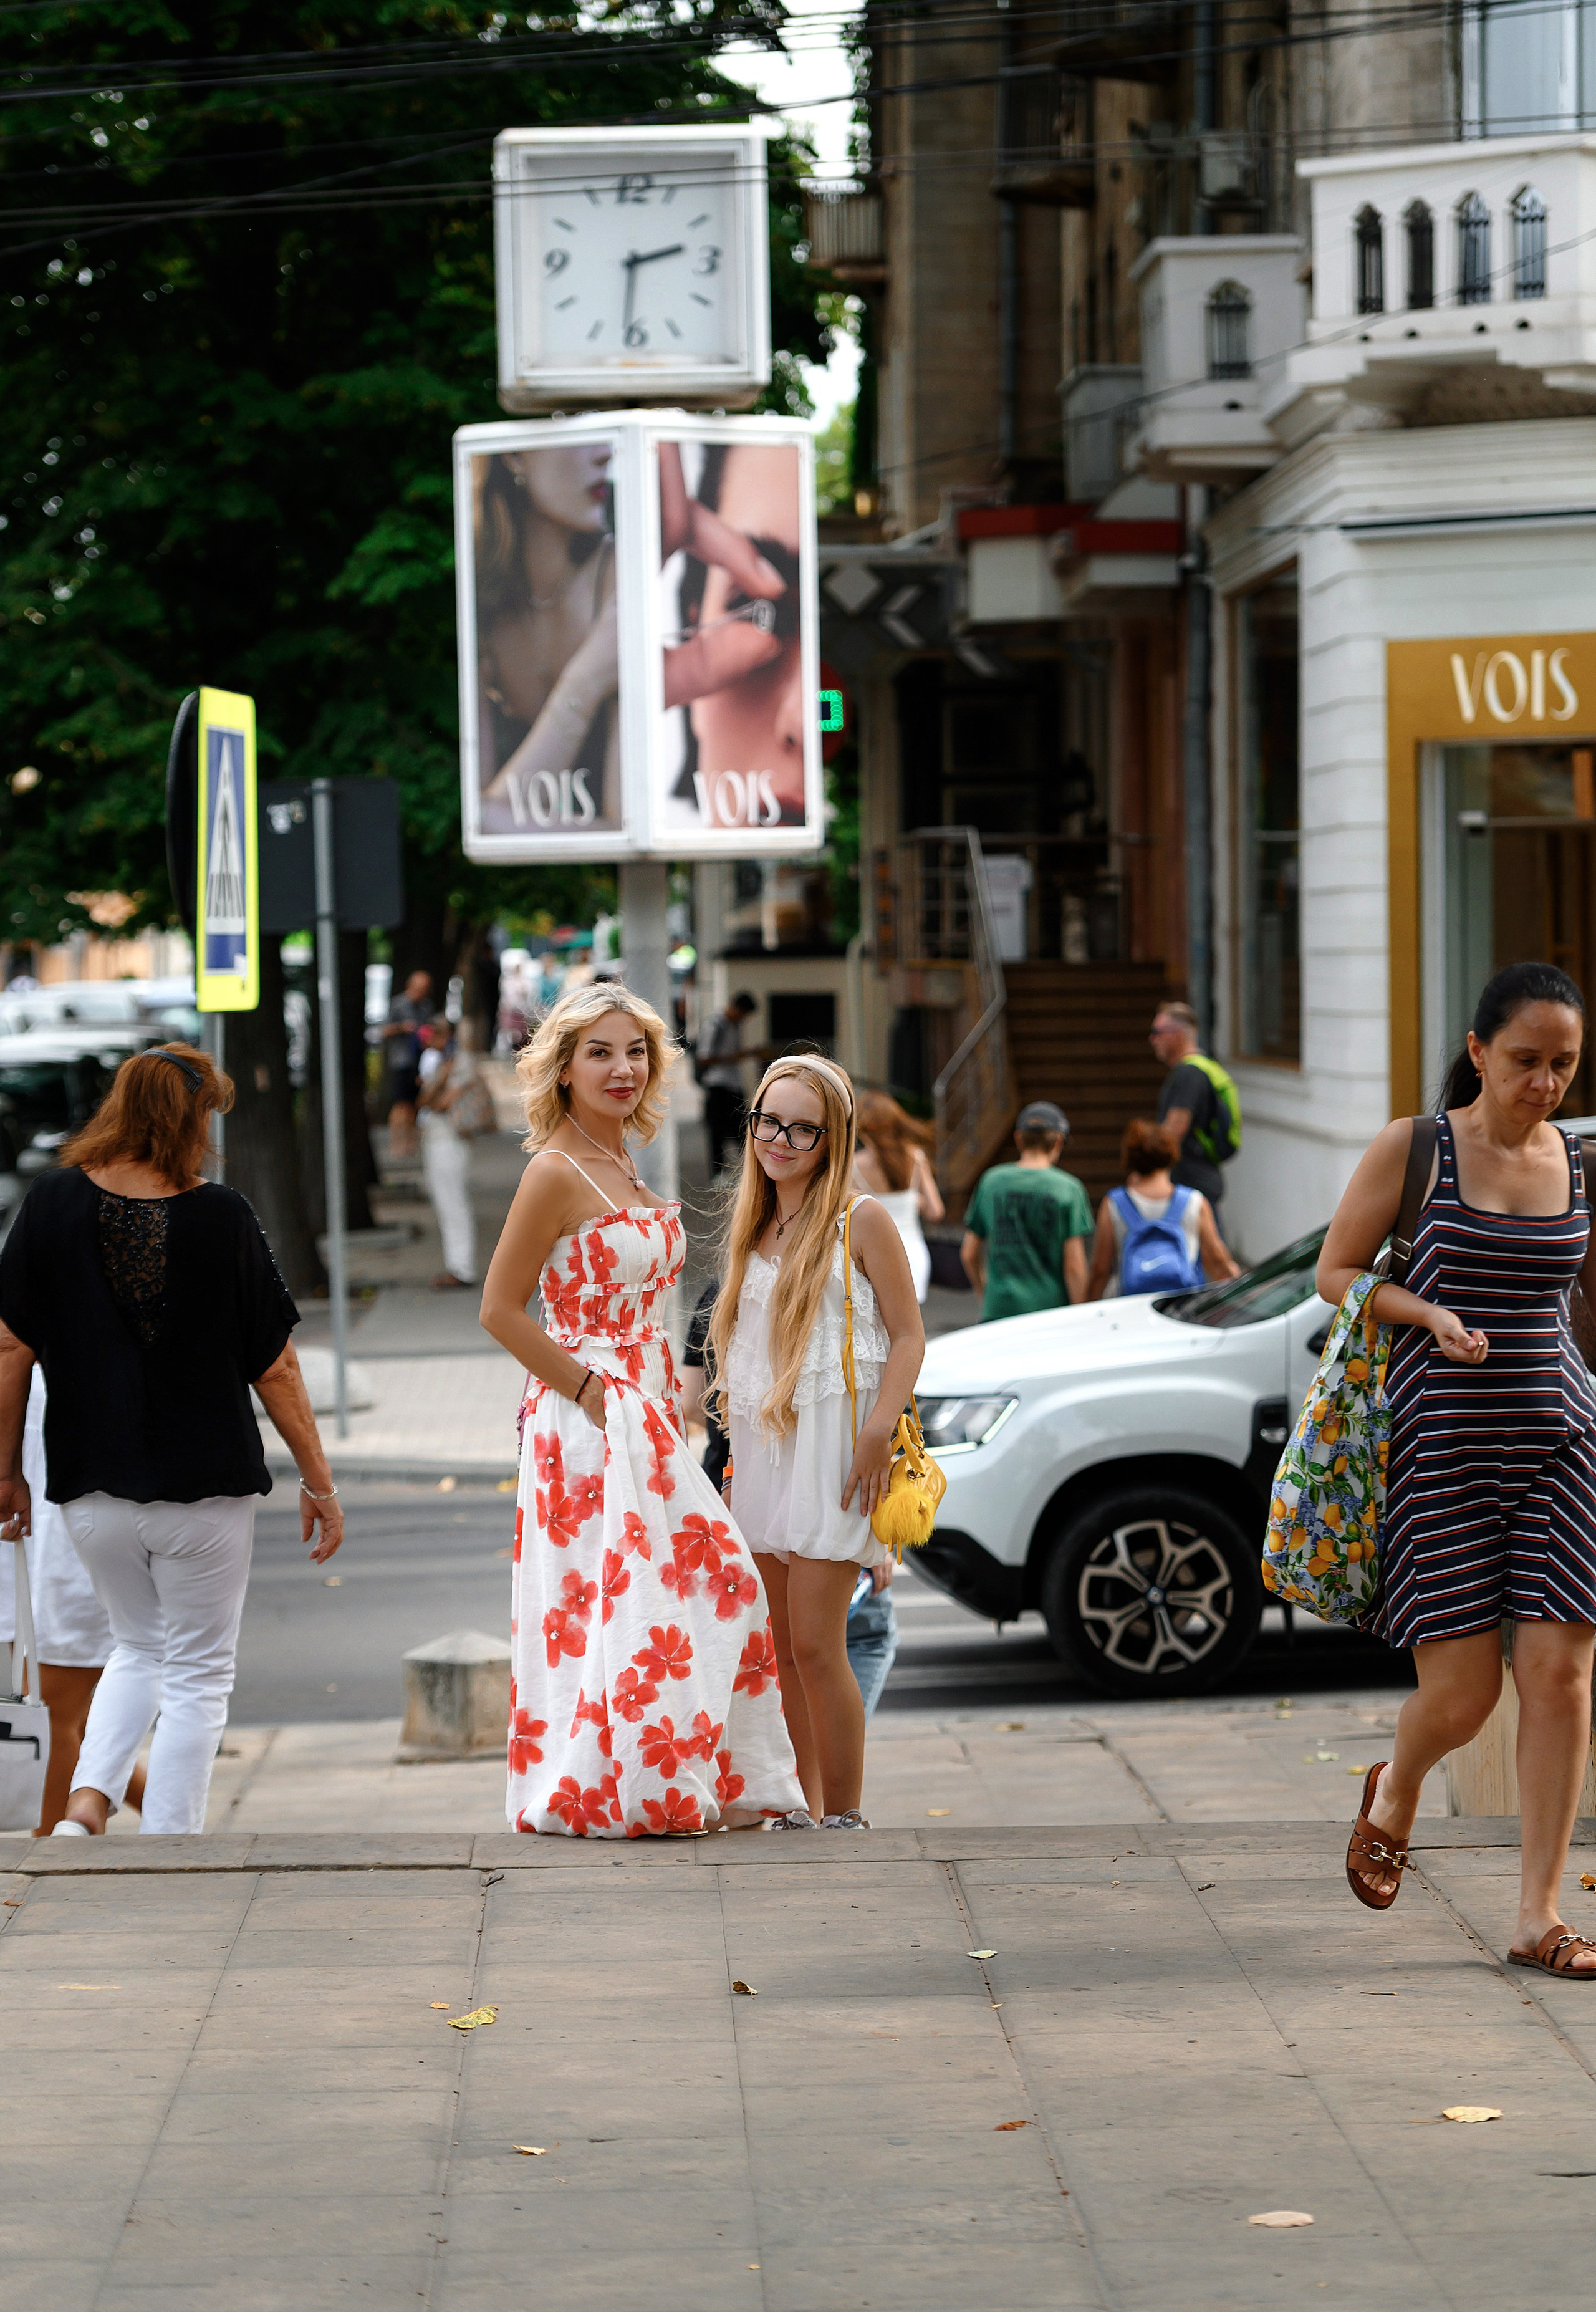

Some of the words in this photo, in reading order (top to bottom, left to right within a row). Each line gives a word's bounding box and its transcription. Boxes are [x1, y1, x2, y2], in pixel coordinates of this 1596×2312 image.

[616, 174, 651, 204] 12
[543, 248, 572, 279] 9
[692, 245, 721, 276] 3
[623, 316, 648, 349] 6
[1450, 648, 1579, 724] VOIS
[506, 768, 596, 827] VOIS
[692, 769, 782, 827] VOIS
